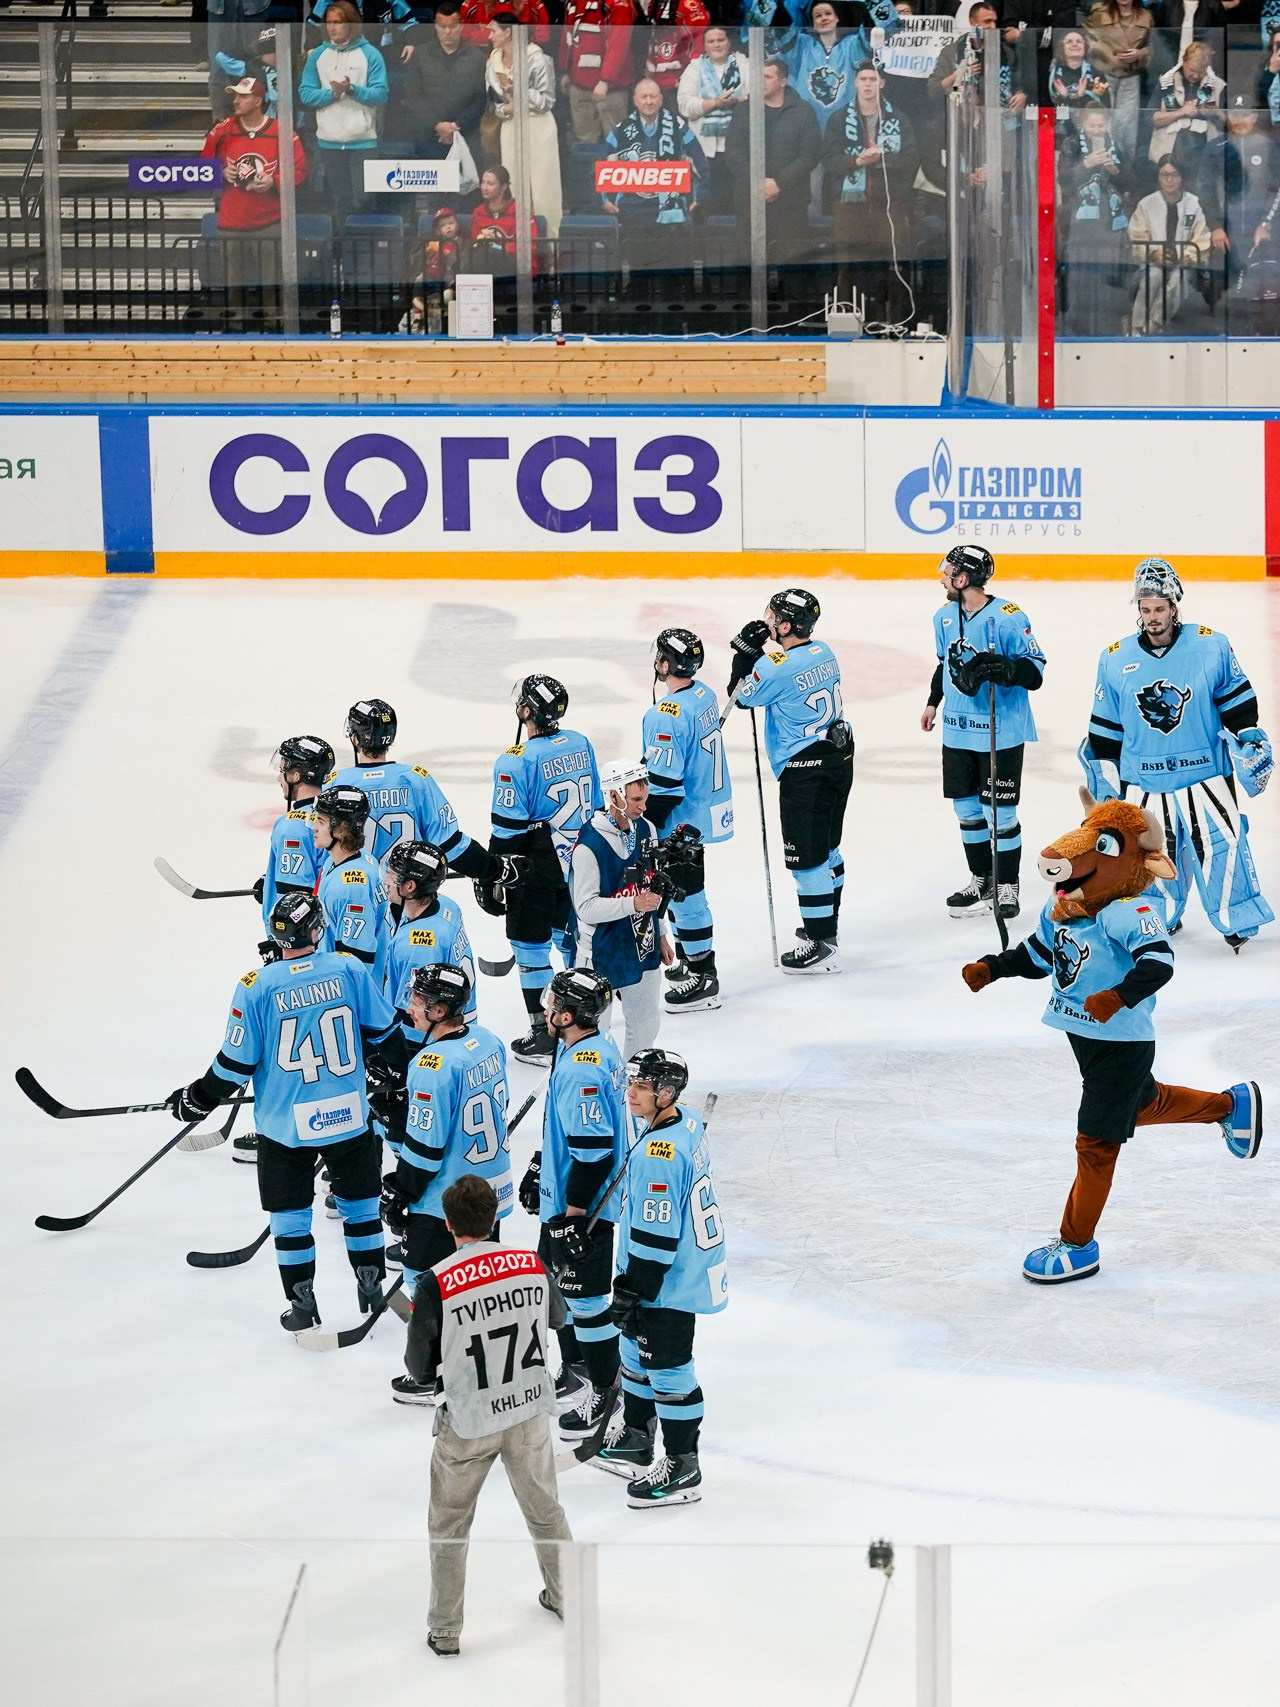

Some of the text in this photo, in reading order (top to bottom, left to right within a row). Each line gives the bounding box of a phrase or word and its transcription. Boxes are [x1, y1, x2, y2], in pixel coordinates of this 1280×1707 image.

[403, 170, 438, 179] ГАЗПРОМ
[598, 168, 688, 185] FONBET
[959, 467, 1082, 498] ГАЗПРОМ
[961, 504, 1079, 518] ТРАНСГАЗ
[957, 523, 1082, 536] БЕЛАРУСЬ
[661, 702, 679, 710] MAX
[661, 708, 679, 717] LINE
[381, 735, 393, 746] 72
[1141, 755, 1212, 772] BSB Bank
[495, 786, 516, 809] 28
[280, 853, 304, 875] 97
[344, 869, 362, 878] MAX
[345, 876, 365, 884] LINE
[342, 917, 366, 940] 37
[412, 930, 431, 939] MAX
[413, 937, 434, 946] LINE
[275, 978, 343, 1013] KALININ
[276, 1005, 358, 1085] 40
[421, 1053, 439, 1062] MAX
[574, 1050, 595, 1058] MAX
[577, 1056, 598, 1064] LINE
[419, 1060, 438, 1069] LINE
[322, 1107, 351, 1121] ГАЗПРОМ
[408, 1104, 434, 1131] 93
[578, 1100, 602, 1126] 14
[650, 1140, 671, 1150] MAX
[650, 1148, 673, 1159] LINE
[641, 1198, 673, 1224] 68
[491, 1384, 542, 1415] KHL.RU
